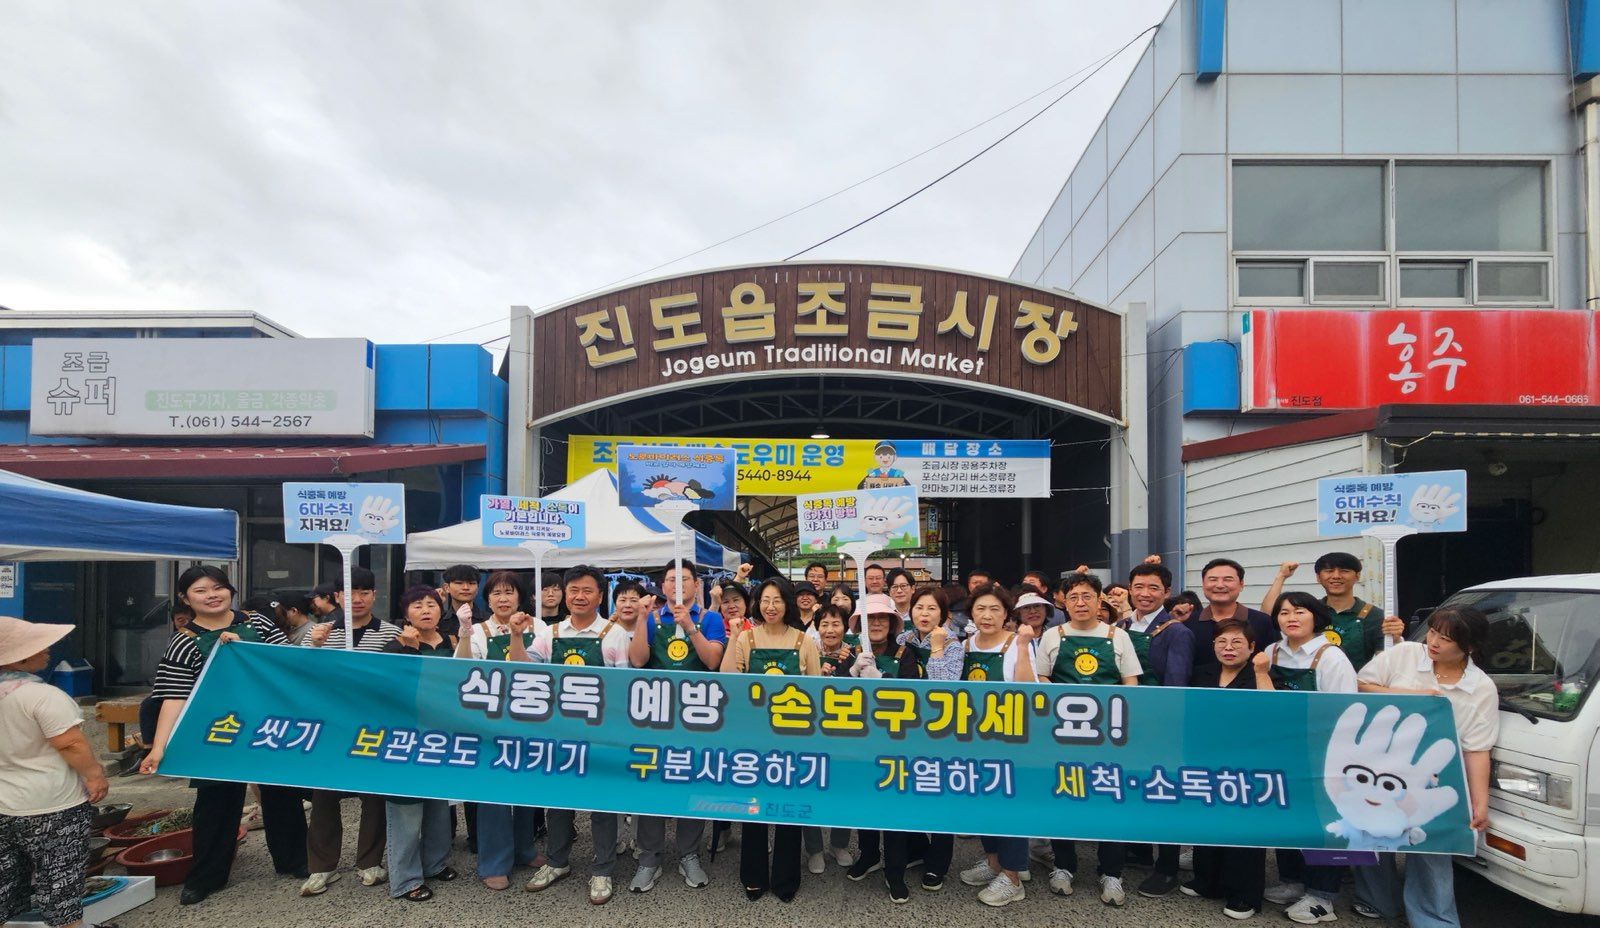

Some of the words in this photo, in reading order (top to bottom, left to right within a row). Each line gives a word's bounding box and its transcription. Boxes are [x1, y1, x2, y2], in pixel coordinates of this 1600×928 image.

[62, 352, 109, 373] 조금
[661, 349, 756, 377] Jogeum
[764, 344, 892, 365] Traditional
[900, 347, 985, 375] Market
[1388, 322, 1467, 394] 홍주
[47, 377, 117, 415] 슈퍼
[169, 415, 225, 429] T.(061)
[231, 415, 313, 428] 544-2567
[802, 443, 845, 467] 운영
[921, 461, 959, 471] 조금시장
[961, 461, 1007, 471] 공용주차장
[921, 472, 968, 482] 포산삼거리
[970, 472, 1016, 482] 버스정류장
[970, 483, 1016, 494] 버스정류장
[1334, 483, 1368, 493] 식중독
[1371, 482, 1393, 492] 예방
[297, 490, 326, 500] 식중독
[327, 490, 347, 500] 예방
[1335, 494, 1401, 509] 6대수칙
[299, 503, 353, 516] 6대수칙
[803, 498, 833, 510] 식중독
[835, 496, 857, 508] 예방
[803, 508, 833, 520] 6가지
[1335, 510, 1396, 524] 지켜요!
[299, 518, 349, 532] 지켜요!
[804, 520, 838, 531] 지켜요!
[460, 668, 603, 720] 식중독
[629, 679, 725, 726] 예방
[207, 714, 242, 744] 손
[252, 717, 321, 752] 씻기
[350, 728, 479, 766] 보관온도
[494, 739, 586, 774] 지키기
[629, 747, 827, 788] 구분사용하기
[878, 758, 1012, 795] 가열하기
[765, 802, 812, 818] 진도군
